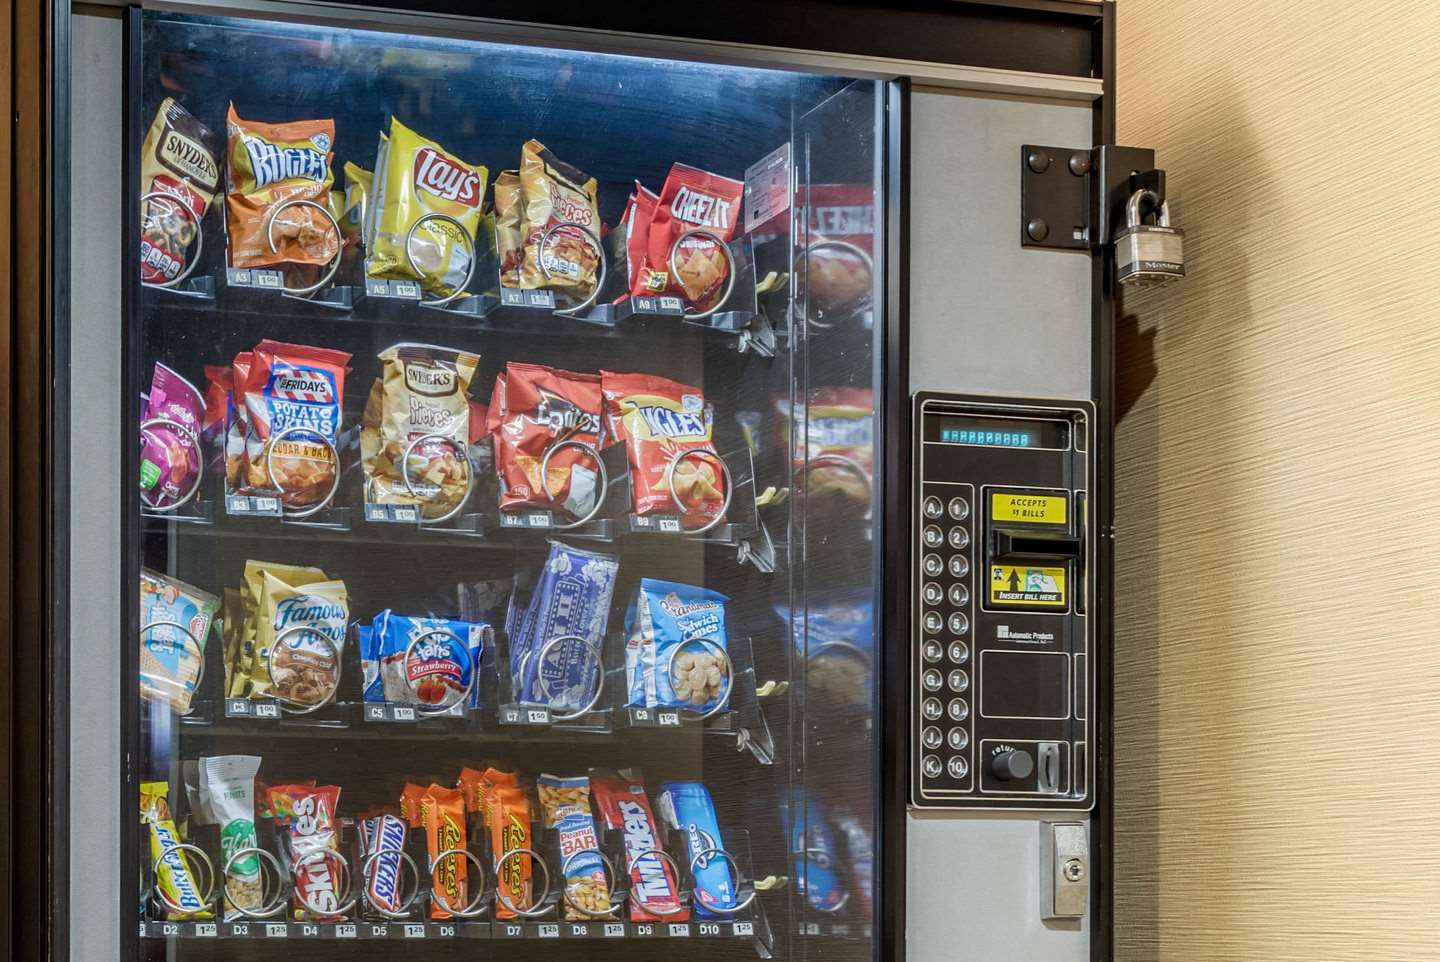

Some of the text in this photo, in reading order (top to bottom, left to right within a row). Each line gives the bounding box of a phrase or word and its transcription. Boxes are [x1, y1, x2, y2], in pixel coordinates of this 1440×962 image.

[417, 147, 480, 201] Lay's
[286, 378, 326, 392] FRIDAYS
[274, 401, 331, 418] POTATO
[927, 503, 935, 513] A
[1010, 499, 1048, 507] ACCEPTS
[954, 504, 960, 515] 1
[927, 531, 935, 542] B
[953, 533, 960, 543] 2
[927, 560, 935, 571] C
[953, 561, 960, 572] 3
[927, 589, 935, 599] D
[953, 590, 960, 601] 4
[999, 592, 1024, 600] INSERT
[274, 595, 346, 631] Famous
[927, 617, 935, 628] E
[953, 618, 960, 629] 5
[927, 646, 935, 656] F
[953, 647, 960, 658] 6
[411, 661, 456, 675] Strawberry
[926, 675, 935, 685] G
[953, 676, 960, 686] 7
[926, 704, 934, 714] H
[953, 704, 960, 715] 8
[927, 733, 934, 744] J
[953, 733, 960, 744] 9
[992, 744, 1016, 755] retur
[927, 761, 935, 771] K
[950, 762, 962, 772] 10
[560, 827, 594, 842] Peanut
[561, 836, 597, 858] BAR
[444, 815, 460, 897] Reese's
[510, 814, 526, 897] Reese's
[163, 926, 179, 935] D2
[234, 925, 248, 935] D3
[303, 926, 318, 935] D4
[372, 927, 387, 936] D5
[440, 927, 454, 936] D6
[507, 926, 521, 936] D7
[638, 926, 652, 935] D9
[700, 925, 718, 934] D10
